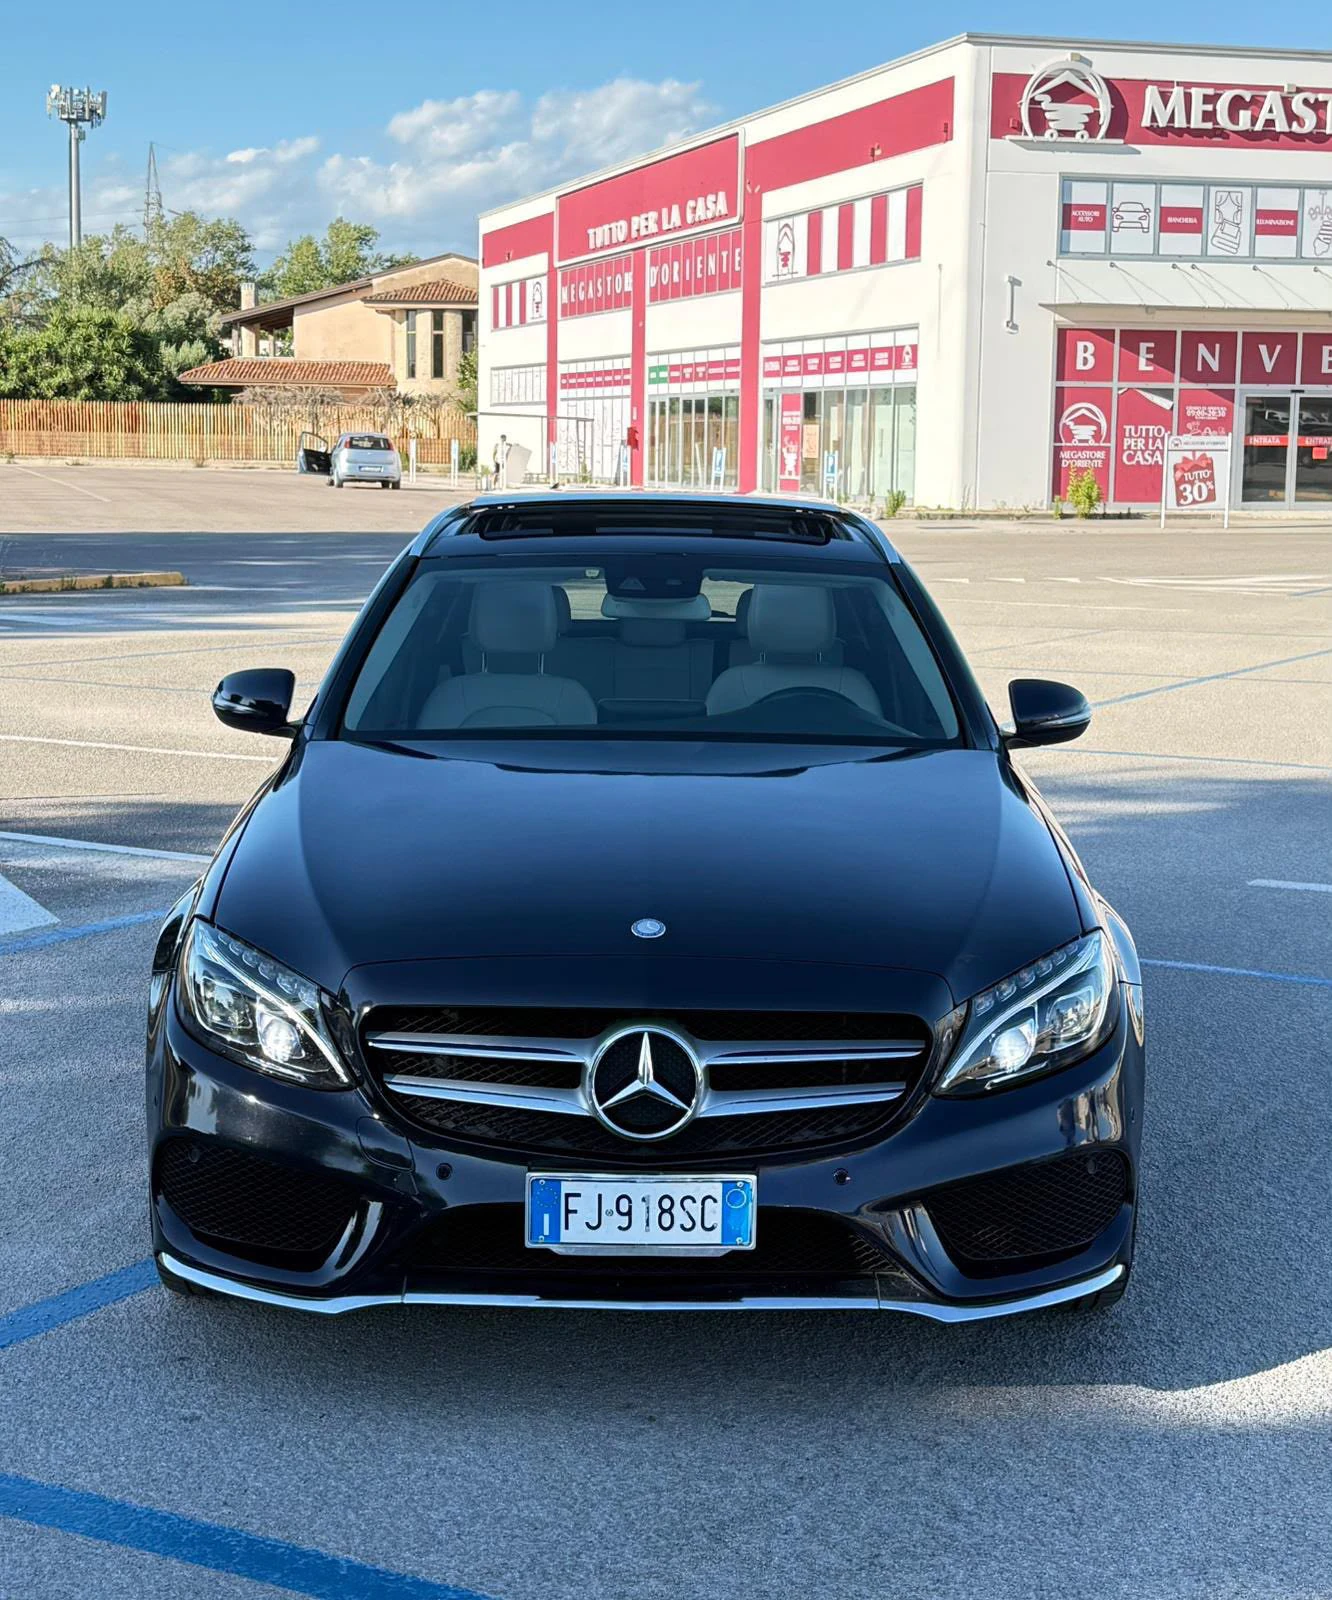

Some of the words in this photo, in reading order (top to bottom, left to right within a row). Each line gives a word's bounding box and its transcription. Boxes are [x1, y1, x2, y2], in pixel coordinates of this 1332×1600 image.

[587, 220, 628, 250] TUTTO
[631, 211, 659, 239] PER
[662, 204, 682, 231] LA
[686, 191, 729, 225] CASA
[649, 248, 742, 289] D'ORIENTE
[1123, 425, 1166, 437] TUTTO
[1123, 437, 1145, 450] PER
[1148, 437, 1163, 450] LA
[1060, 451, 1106, 460] MEGASTORE
[1122, 450, 1163, 466] CASA
[1061, 459, 1103, 468] D'ORIENTE
[1184, 469, 1213, 481] TUTTO
